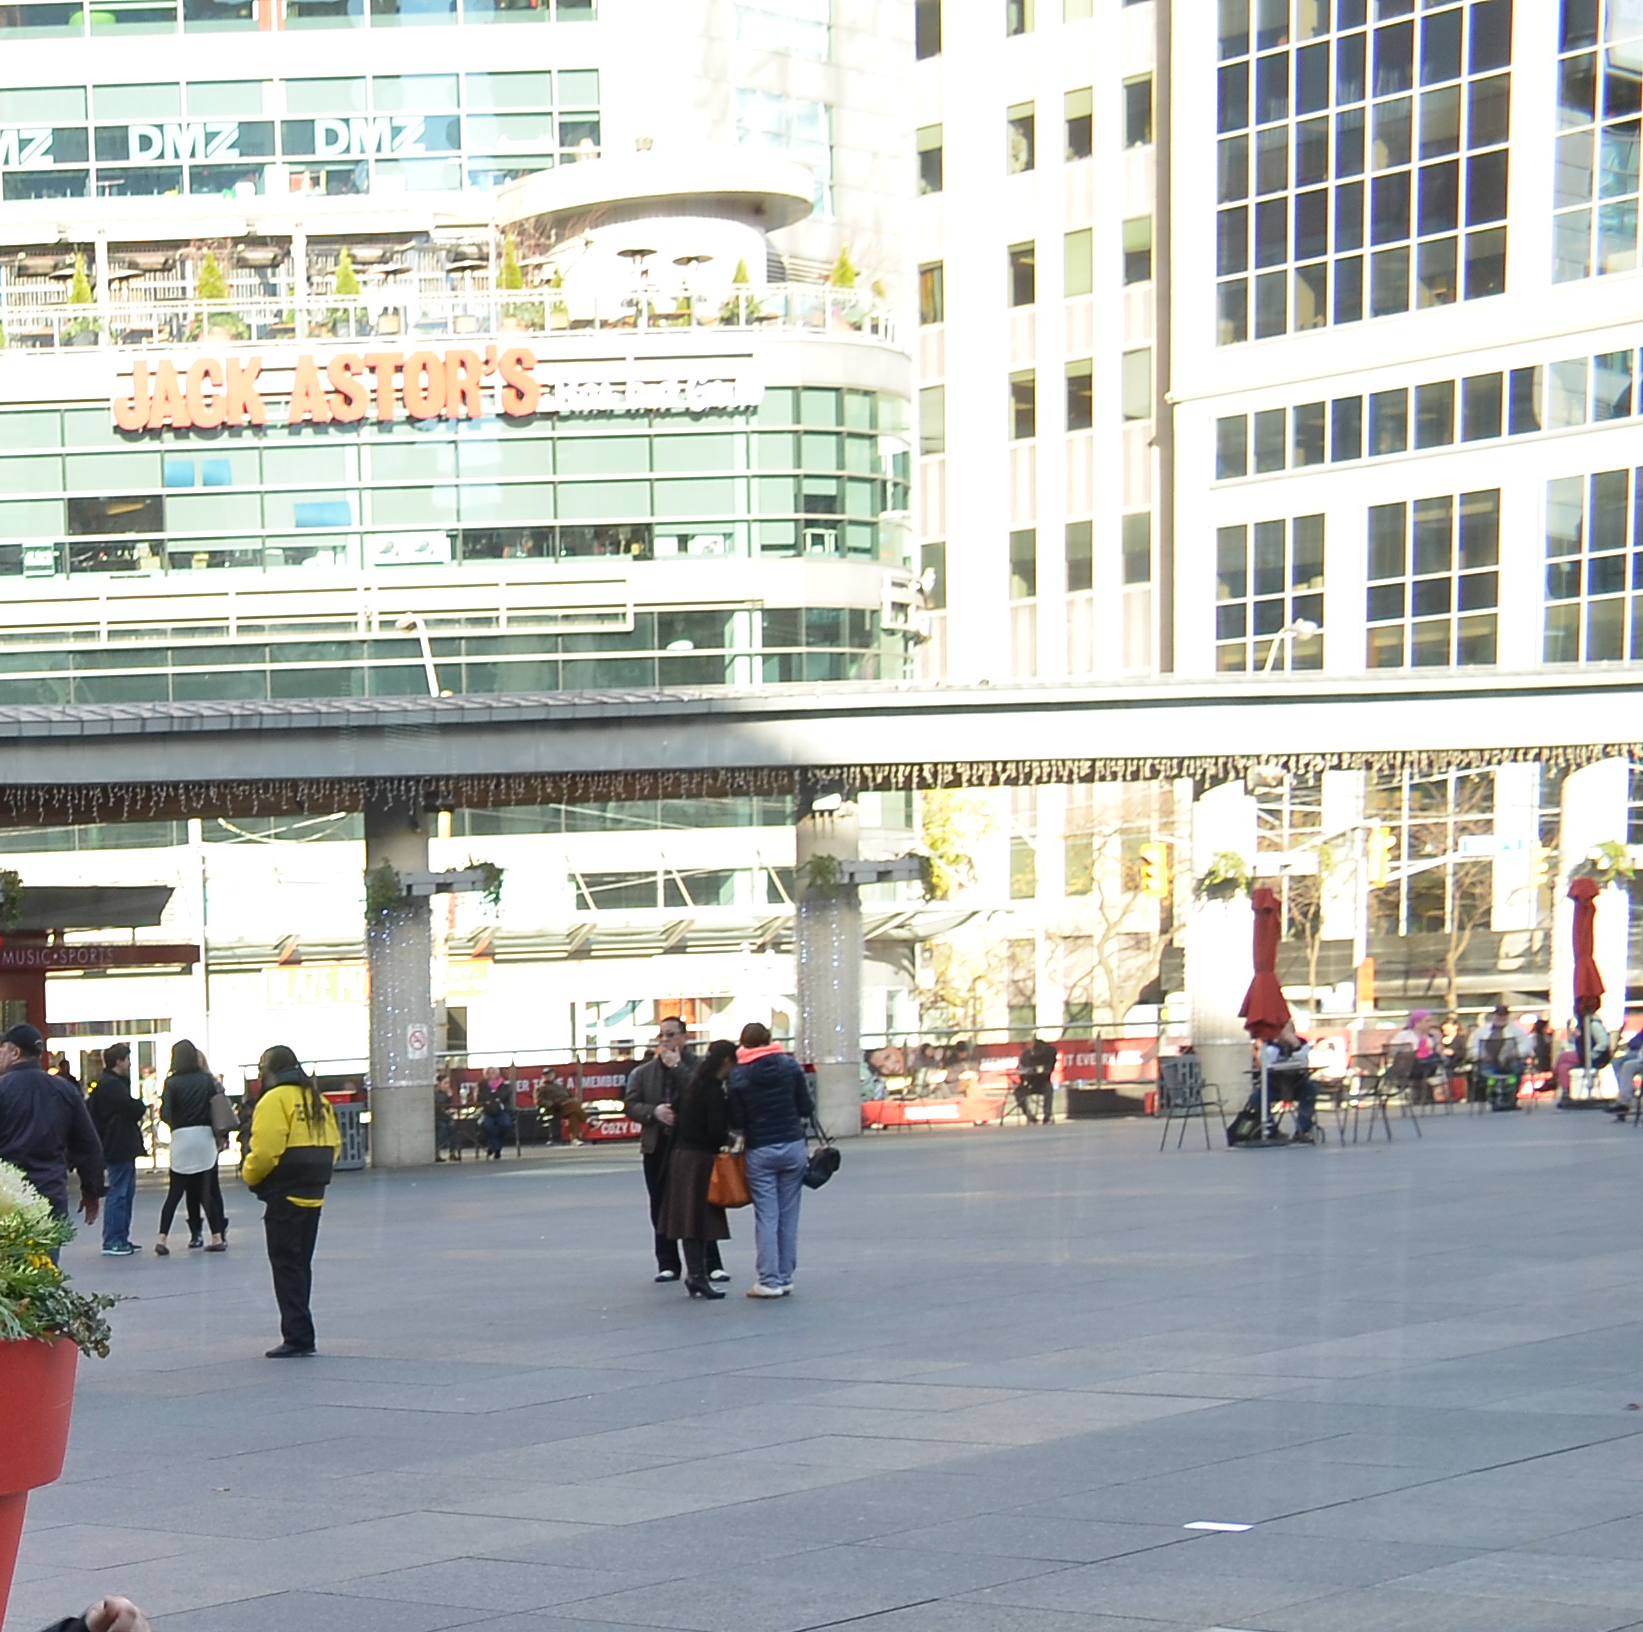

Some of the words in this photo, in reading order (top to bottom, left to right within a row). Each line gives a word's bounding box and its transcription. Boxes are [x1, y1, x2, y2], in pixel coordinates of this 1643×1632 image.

[127, 122, 241, 162] DMZ
[313, 116, 427, 156] DMZ
[113, 356, 267, 432] JACK
[287, 344, 543, 425] ASTOR'S
[2, 949, 51, 965] MUSIC
